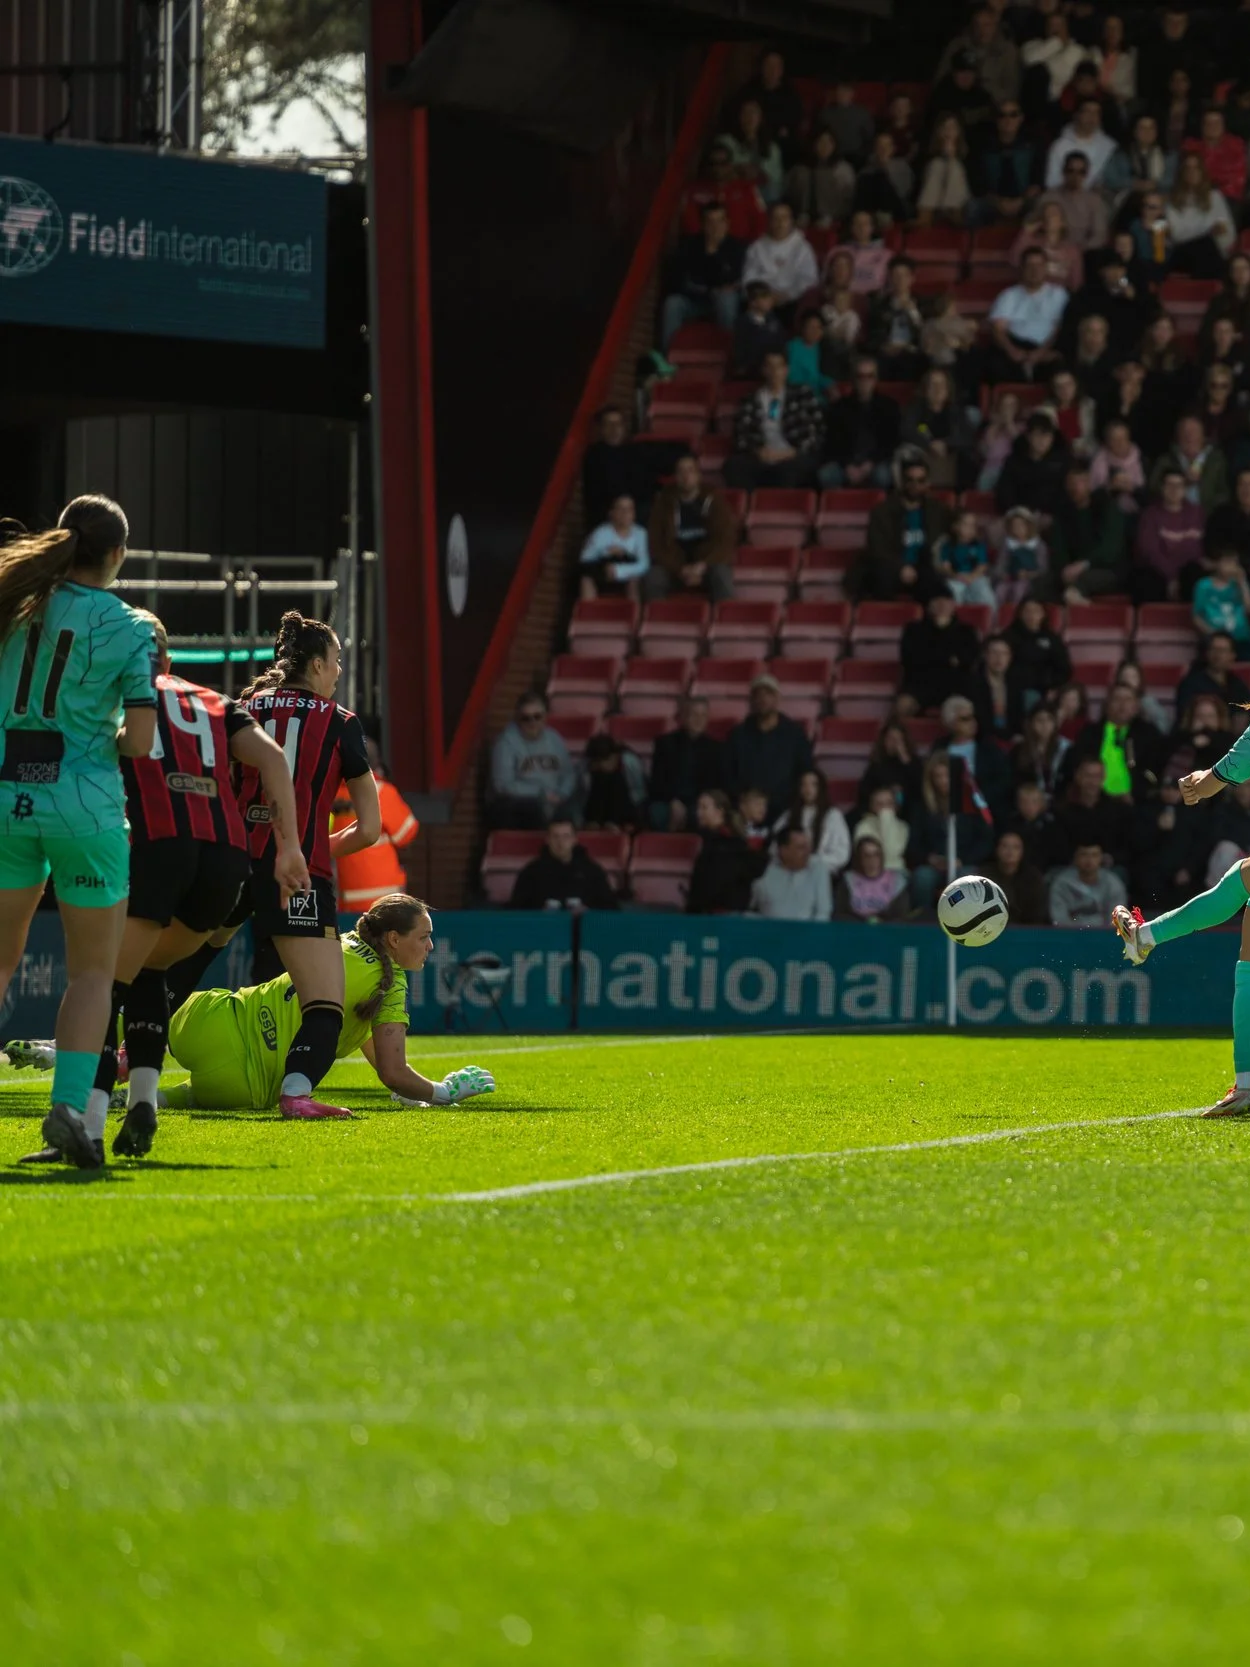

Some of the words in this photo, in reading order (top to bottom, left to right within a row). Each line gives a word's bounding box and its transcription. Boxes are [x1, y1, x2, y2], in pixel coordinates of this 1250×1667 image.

[13, 620, 75, 719] 11
[246, 696, 330, 713] HENNESSY
[149, 687, 216, 767] 4
[17, 762, 59, 774] STONE
[21, 772, 58, 784] RIDGE
[292, 895, 311, 916] IFX
[288, 919, 319, 927] PAYMENTS
